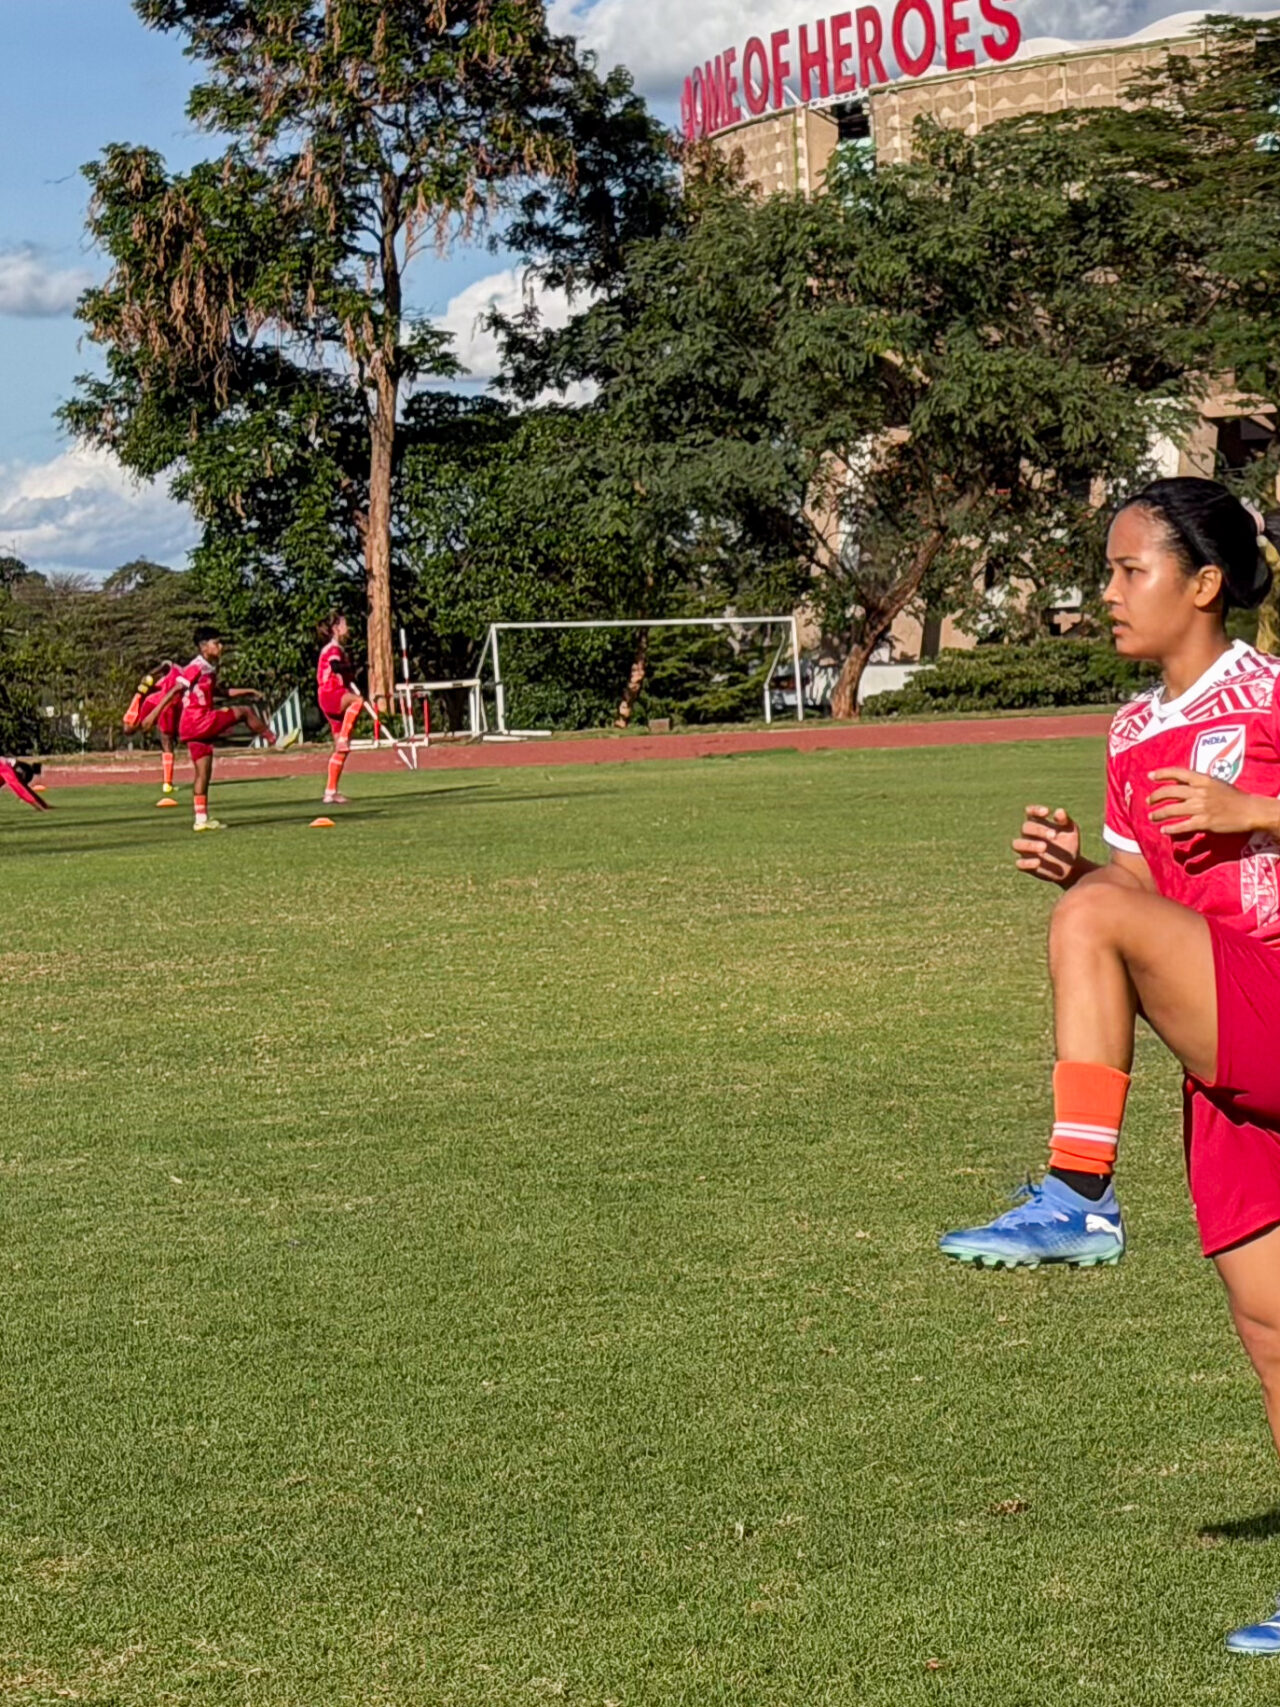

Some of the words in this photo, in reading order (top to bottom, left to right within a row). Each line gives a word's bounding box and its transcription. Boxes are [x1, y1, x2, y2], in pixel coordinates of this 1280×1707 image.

[742, 28, 790, 115] OF
[799, 0, 1021, 102] HEROES
[1202, 735, 1227, 746] INDIA
